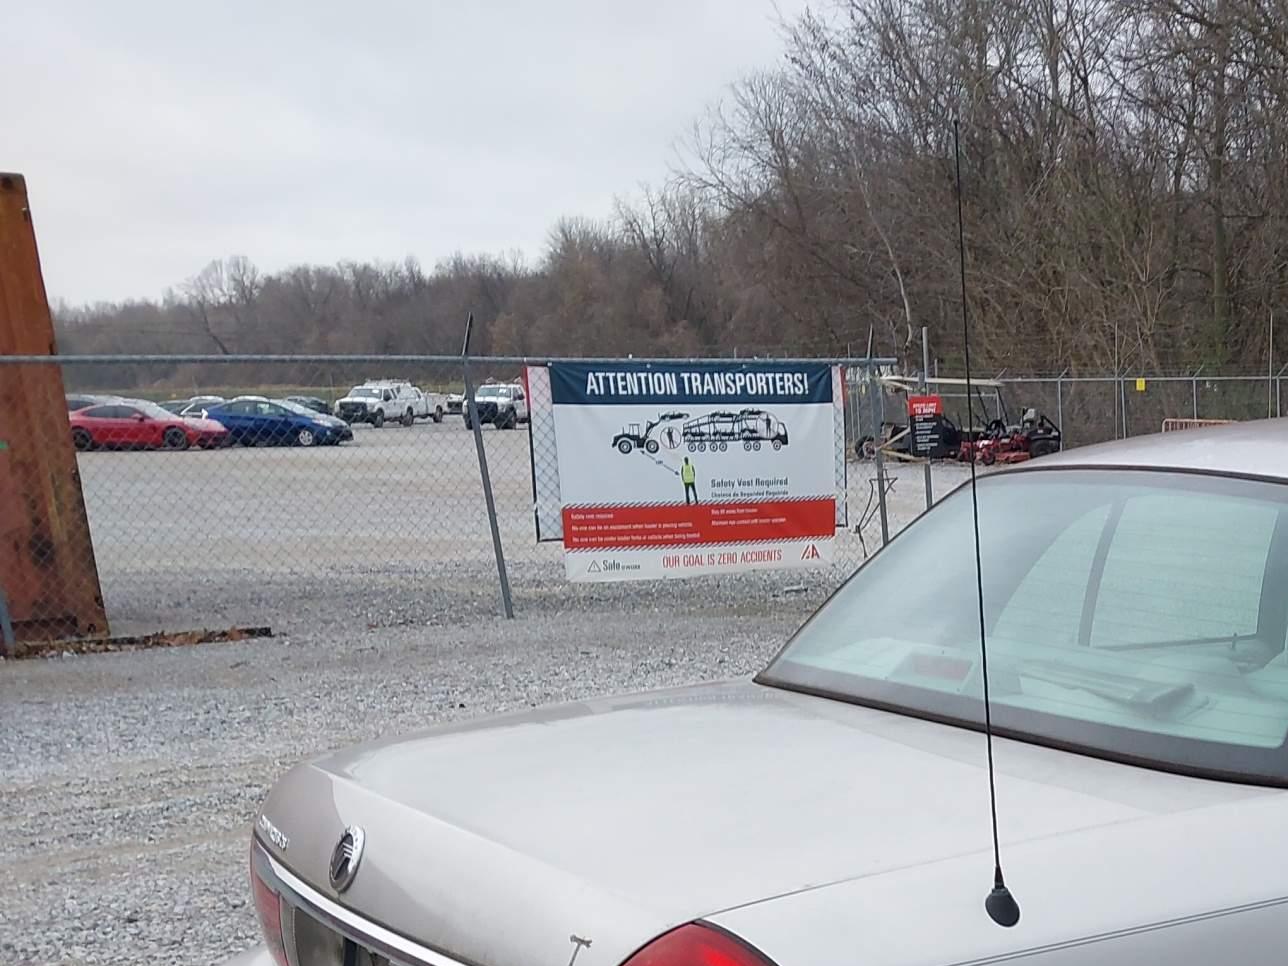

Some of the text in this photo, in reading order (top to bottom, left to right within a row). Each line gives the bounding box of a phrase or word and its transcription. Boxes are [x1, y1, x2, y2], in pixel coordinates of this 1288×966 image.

[586, 372, 809, 395] ATTENTION TRANSPORTERS!
[711, 477, 788, 489] Safety Vest Required
[662, 550, 782, 568] OUR GOAL IS ZERO ACCIDENTS
